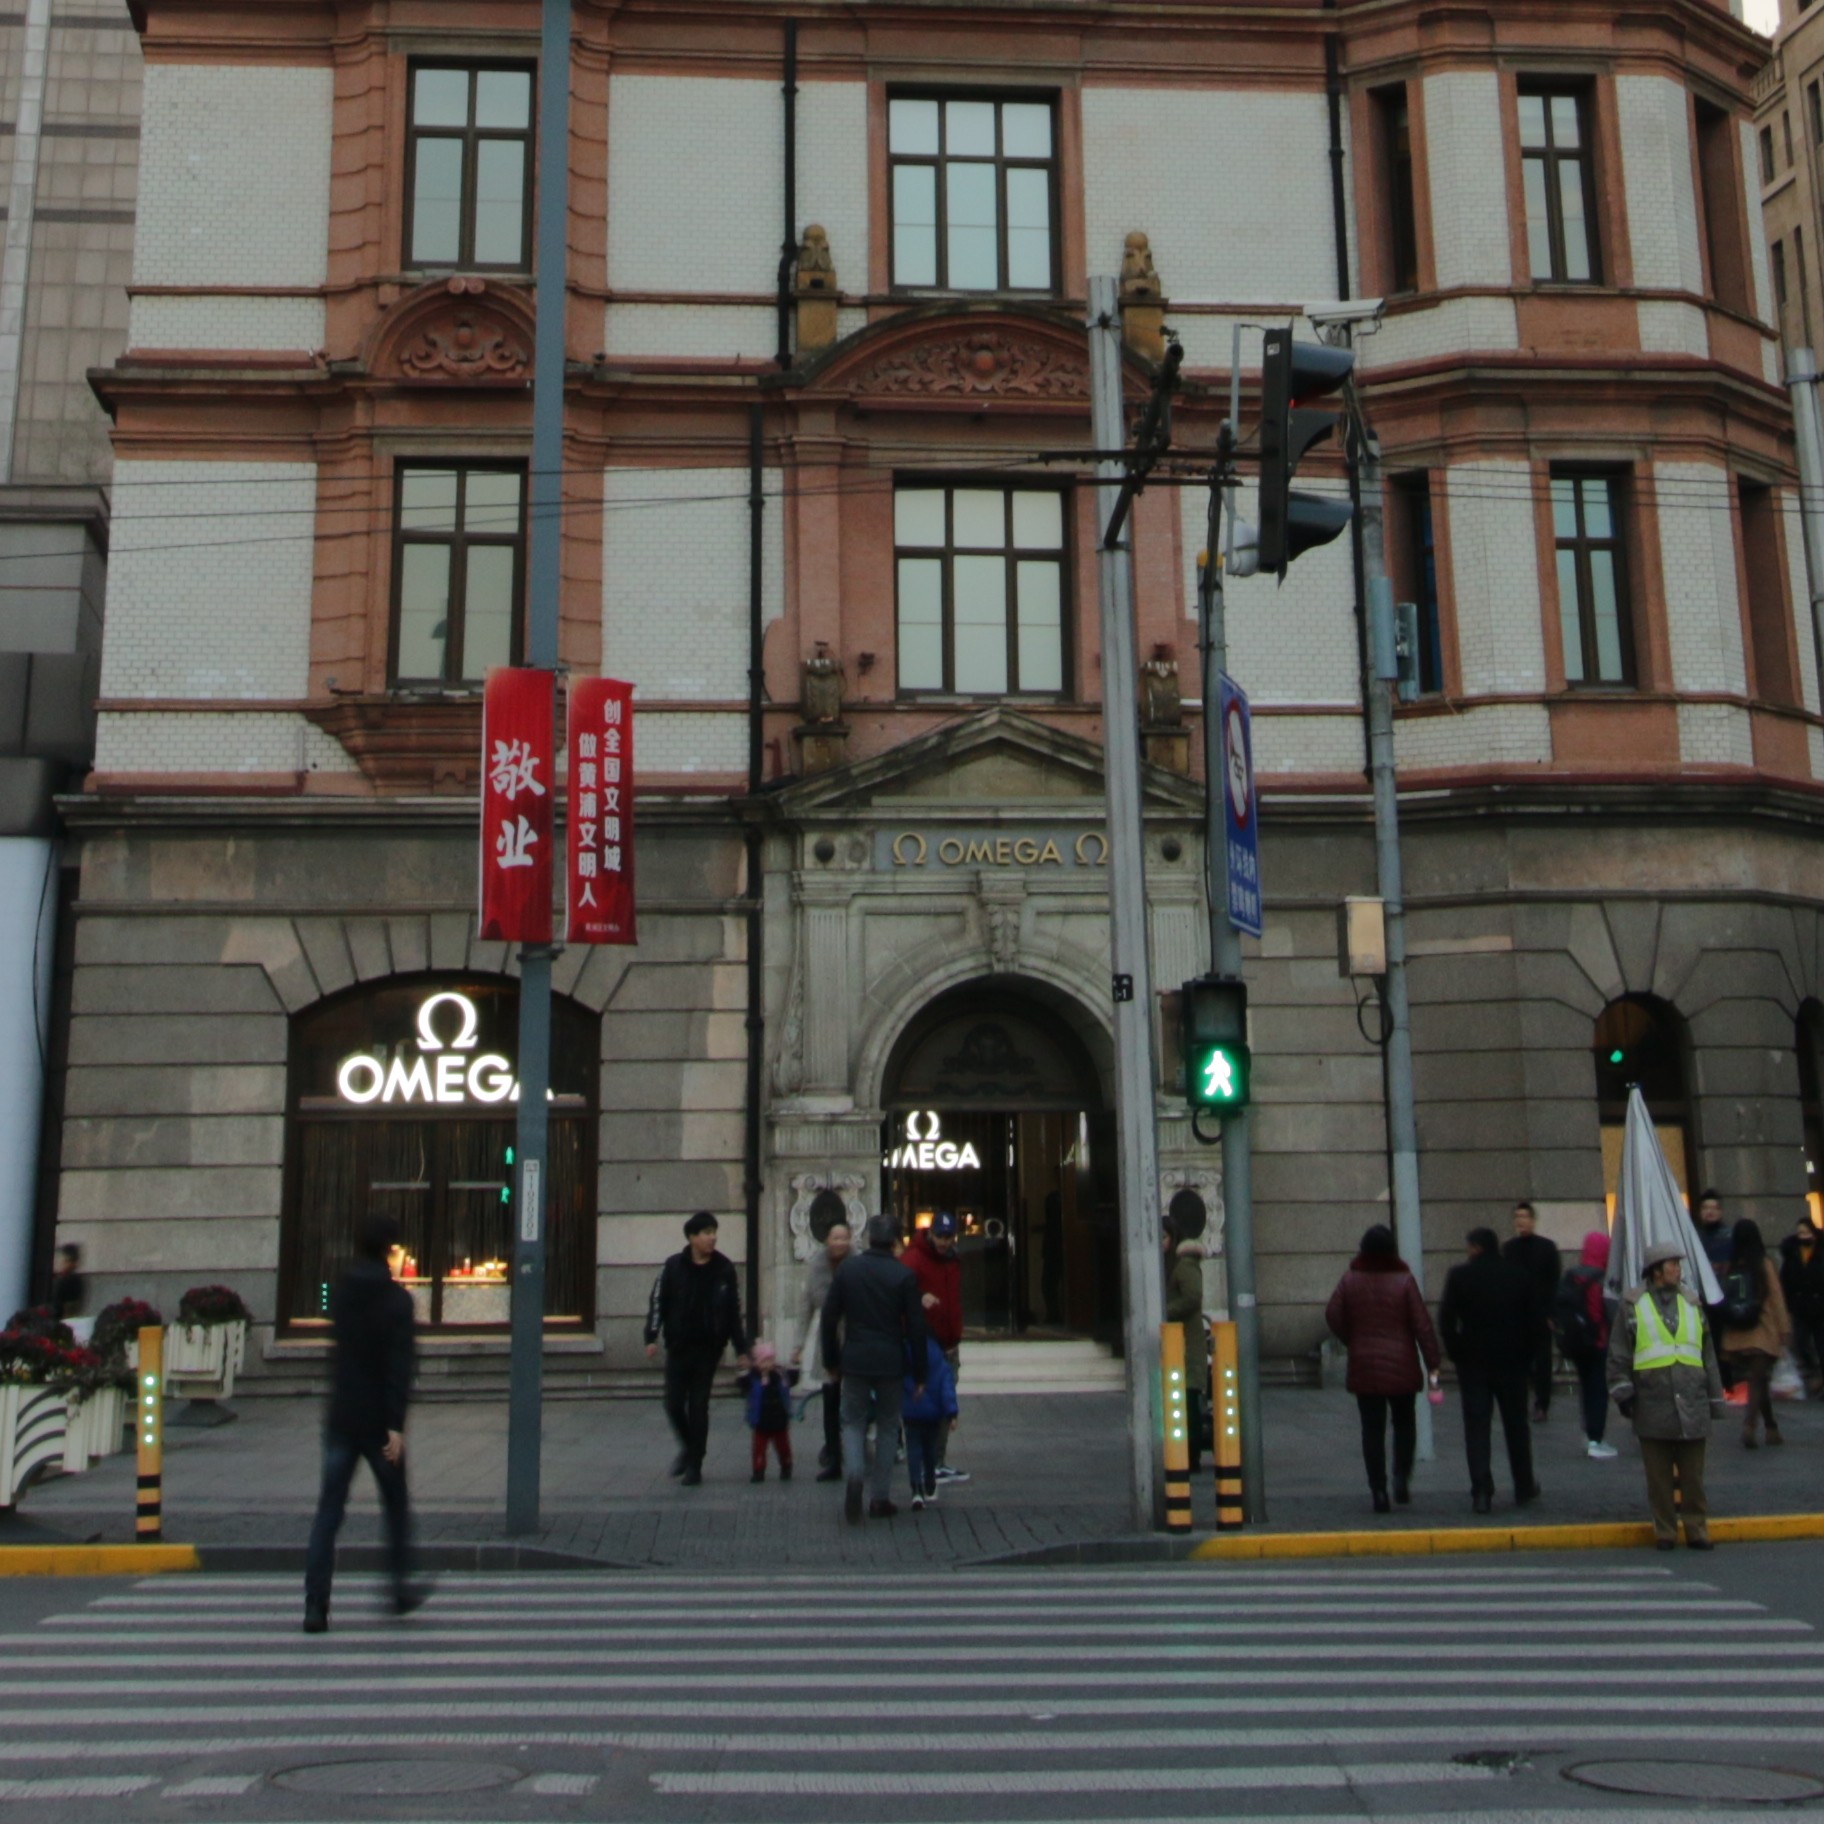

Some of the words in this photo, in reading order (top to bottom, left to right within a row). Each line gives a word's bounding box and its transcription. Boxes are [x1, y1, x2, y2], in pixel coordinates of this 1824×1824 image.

[489, 738, 546, 870] 敬业
[578, 732, 598, 909] 做黄浦文明人
[603, 698, 622, 873] 创全国文明城
[938, 838, 1064, 866] OMEGA
[338, 1054, 555, 1104] OMEG
[882, 1141, 981, 1170] MEGA
